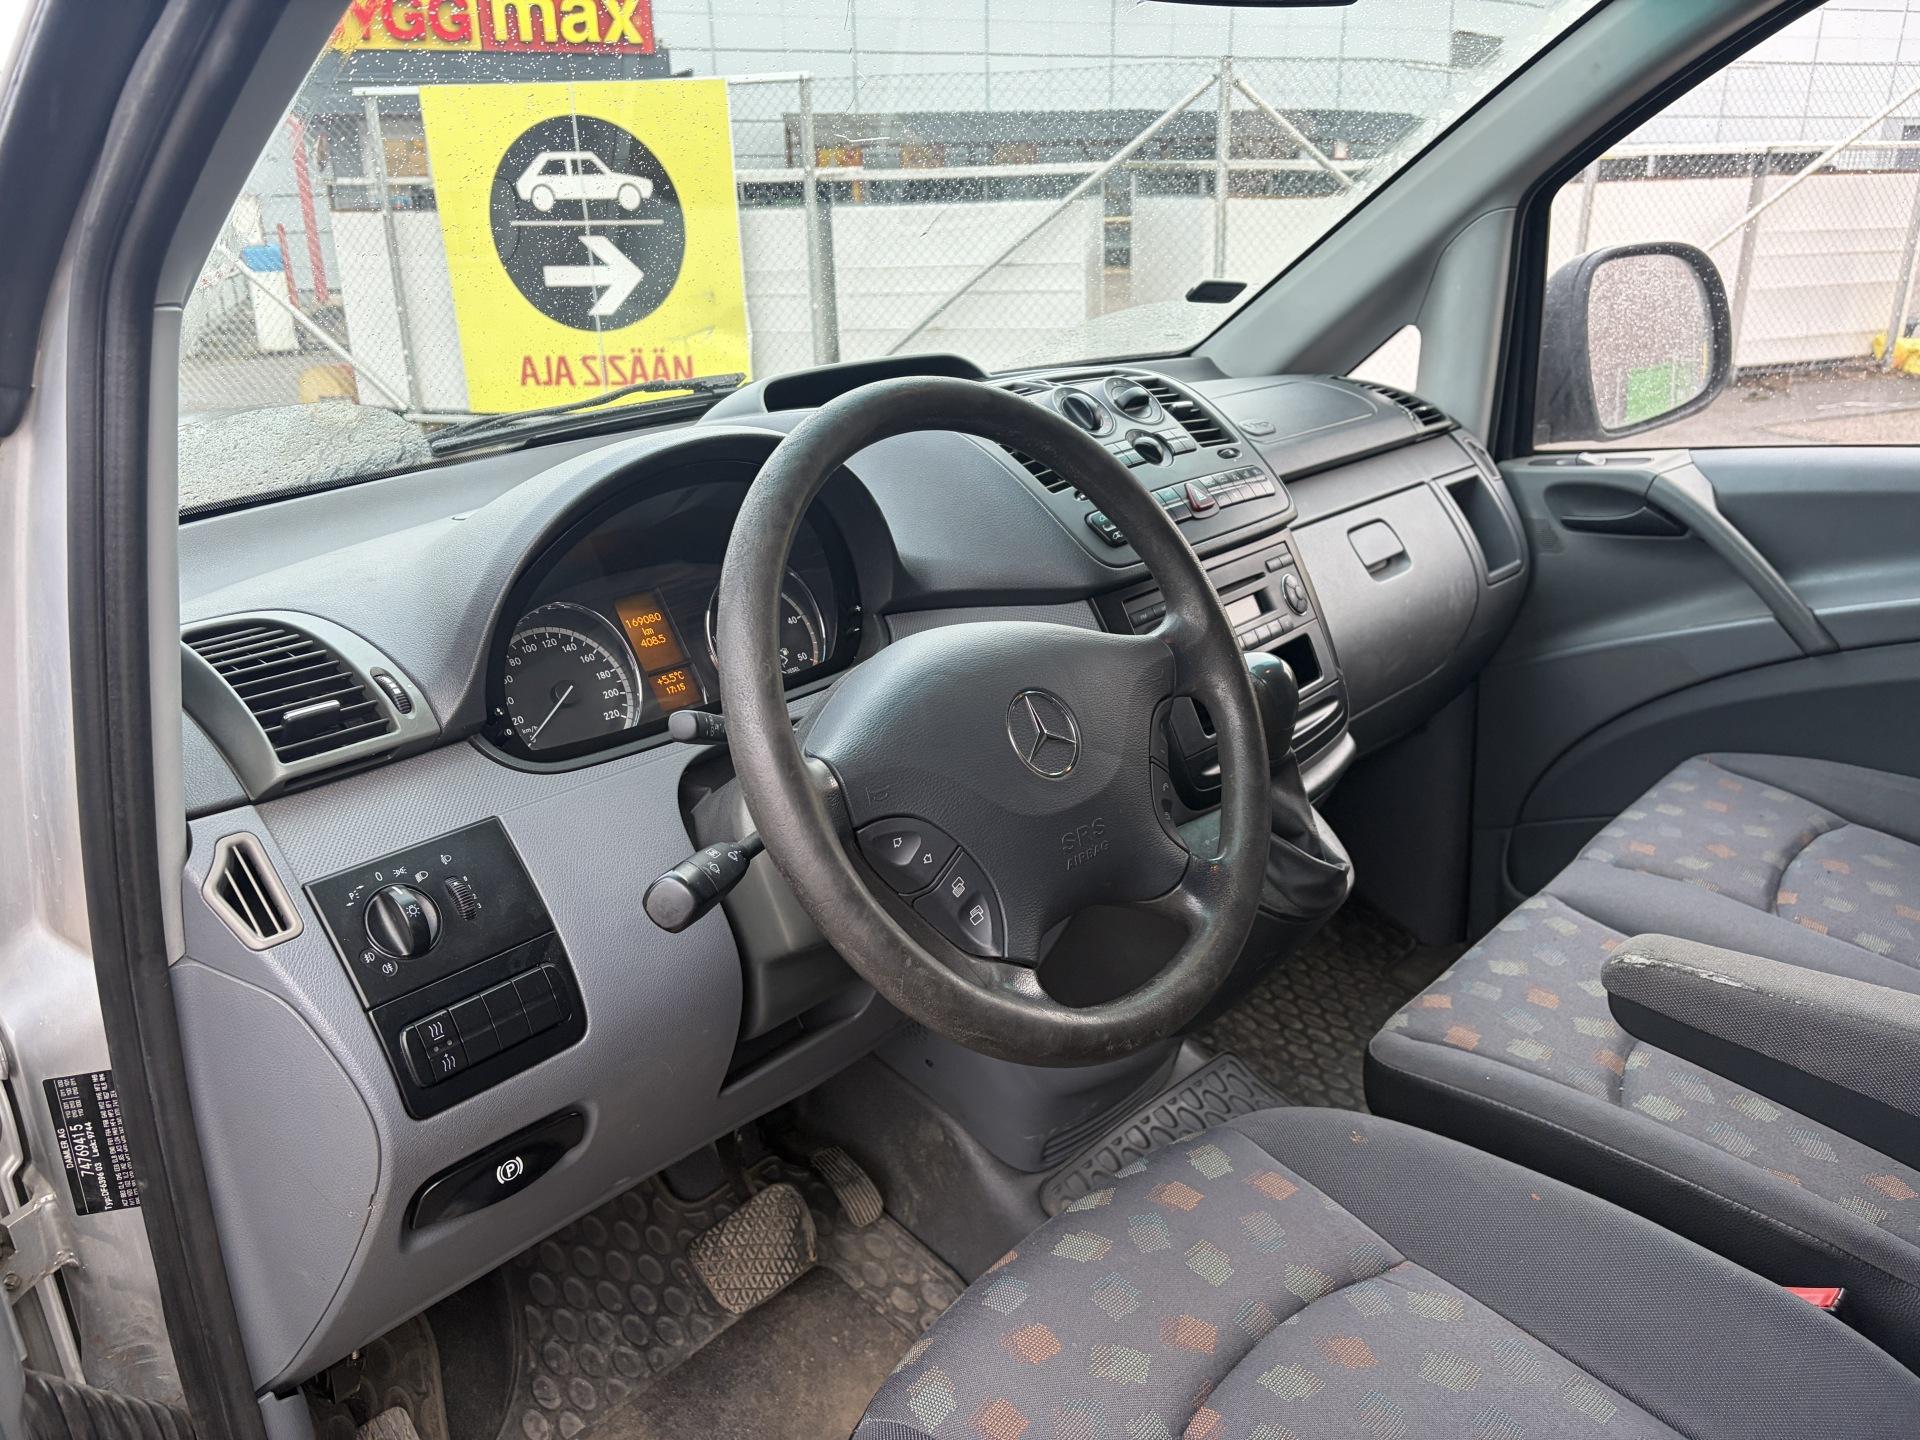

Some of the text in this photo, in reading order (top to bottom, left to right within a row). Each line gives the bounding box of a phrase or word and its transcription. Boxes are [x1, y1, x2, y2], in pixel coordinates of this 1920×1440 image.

[520, 348, 694, 387] AJA SISÄÄN
[625, 612, 662, 629] 169080
[788, 616, 797, 624] 40
[641, 627, 655, 636] km
[542, 638, 557, 648] 120
[562, 643, 577, 653] 140
[522, 646, 537, 654] 100
[509, 657, 522, 667] 80
[580, 653, 595, 664] 160
[797, 652, 807, 661] 50
[596, 670, 611, 680] 180
[602, 688, 619, 699] 200
[666, 682, 686, 695] 17:15
[603, 709, 620, 720] 220
[512, 715, 524, 726] 20
[83, 1121, 95, 1138] 9744
[56, 1127, 74, 1168] DAIMLER AG
[68, 1123, 95, 1177] 74769415
[88, 1139, 99, 1156] Lack:
